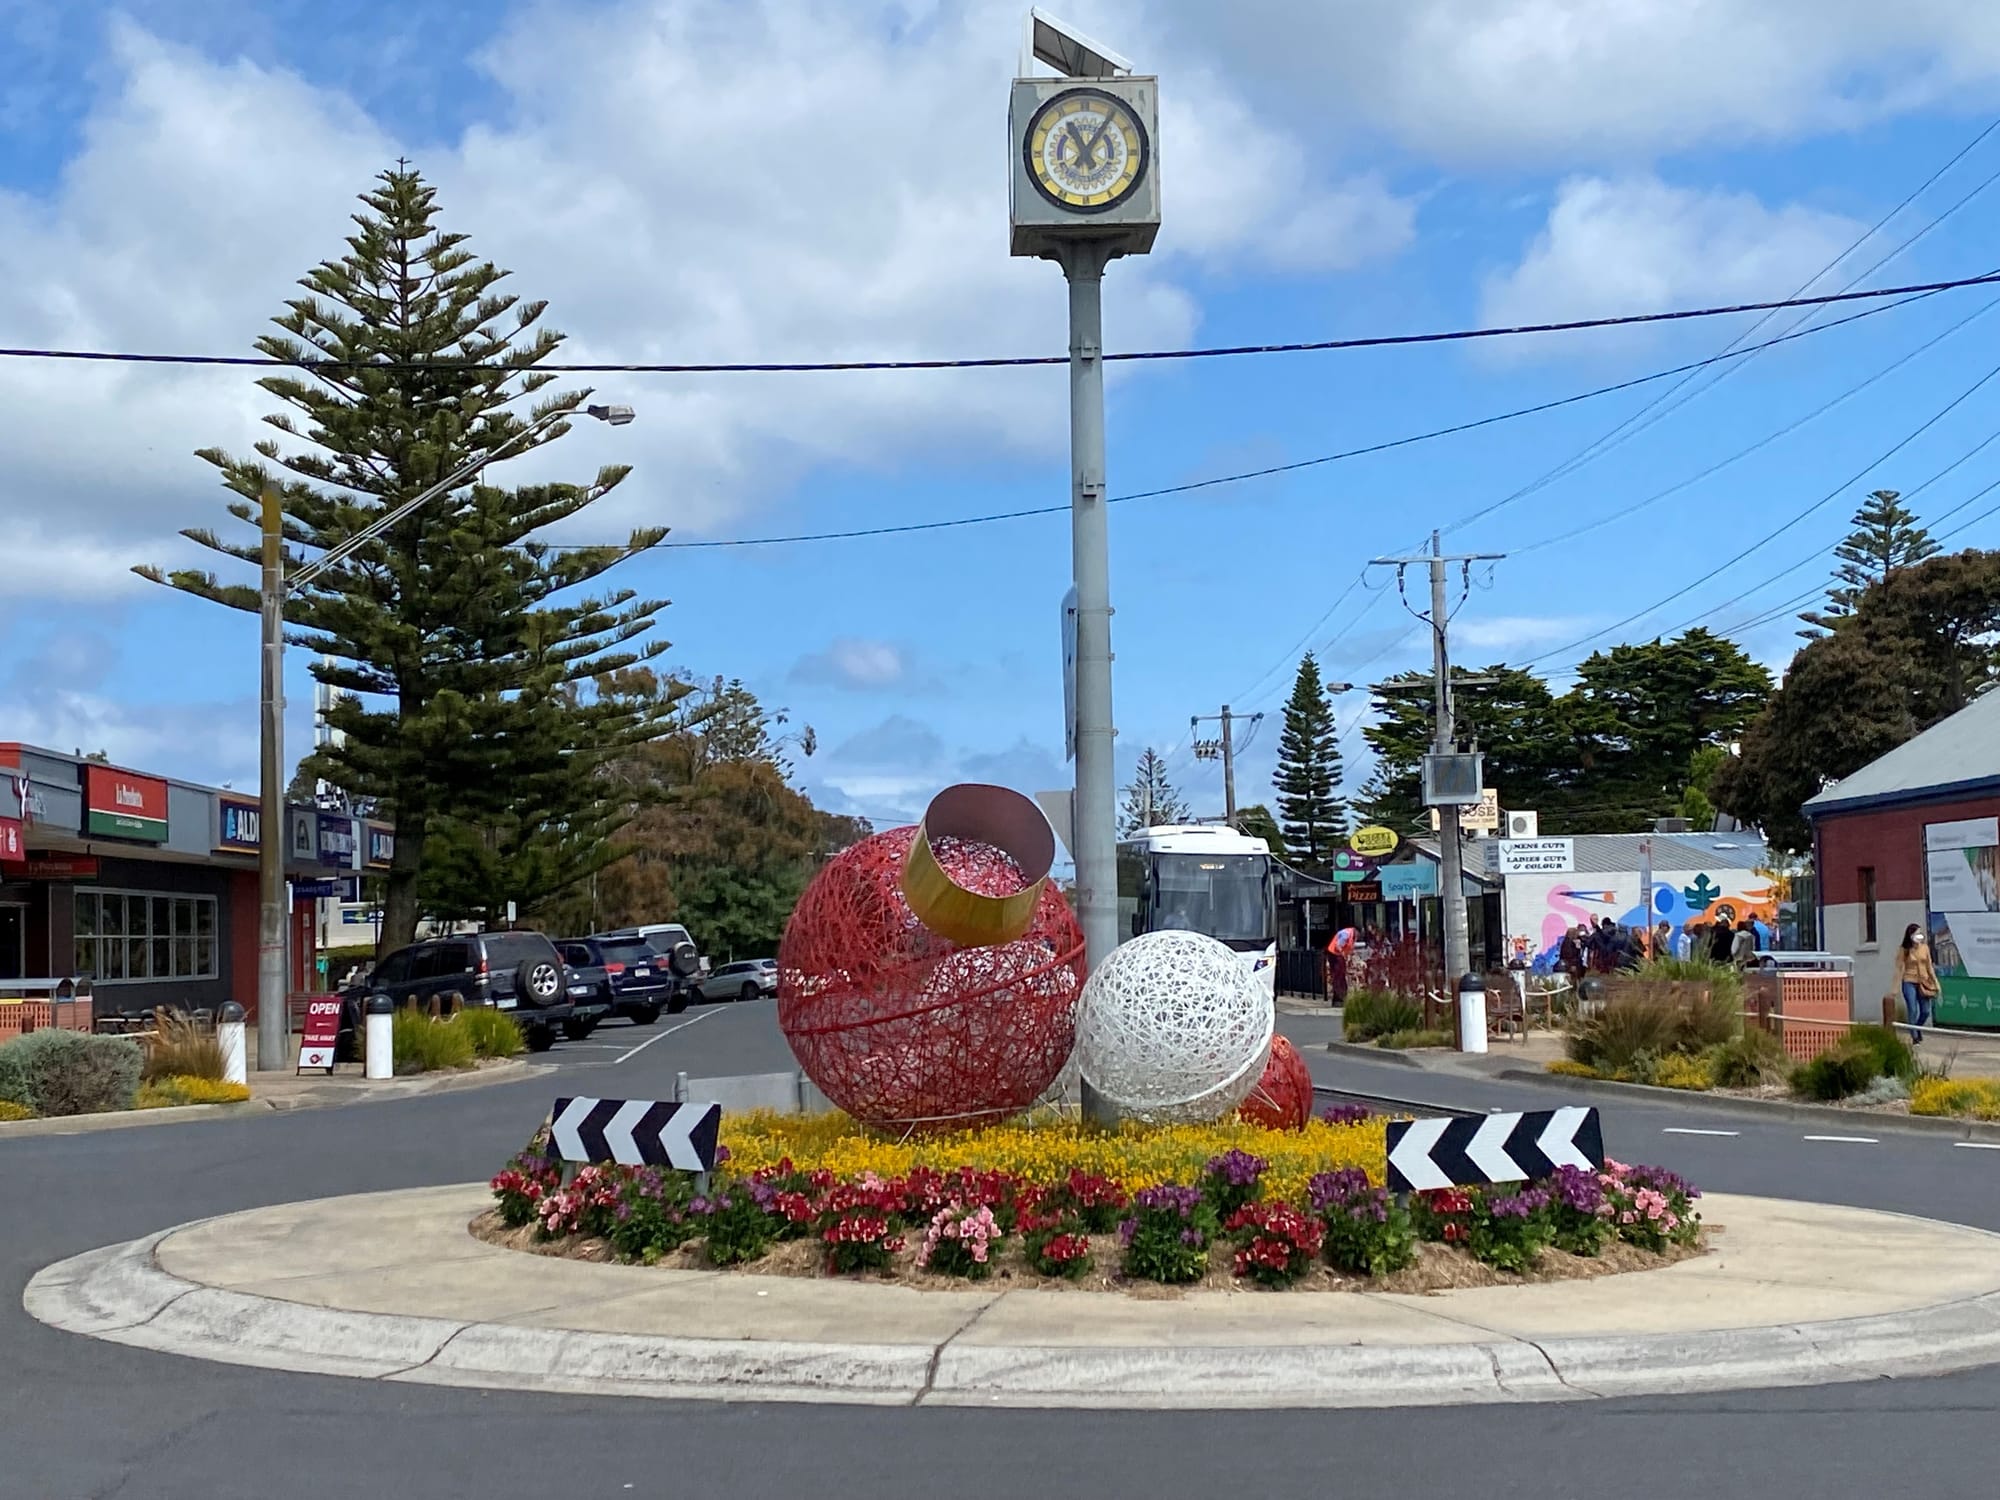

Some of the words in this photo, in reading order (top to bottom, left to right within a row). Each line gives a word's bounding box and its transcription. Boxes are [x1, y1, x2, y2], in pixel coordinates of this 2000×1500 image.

[237, 810, 260, 843] ALDI
[1347, 890, 1377, 901] Pizza
[309, 1002, 340, 1015] OPEN
